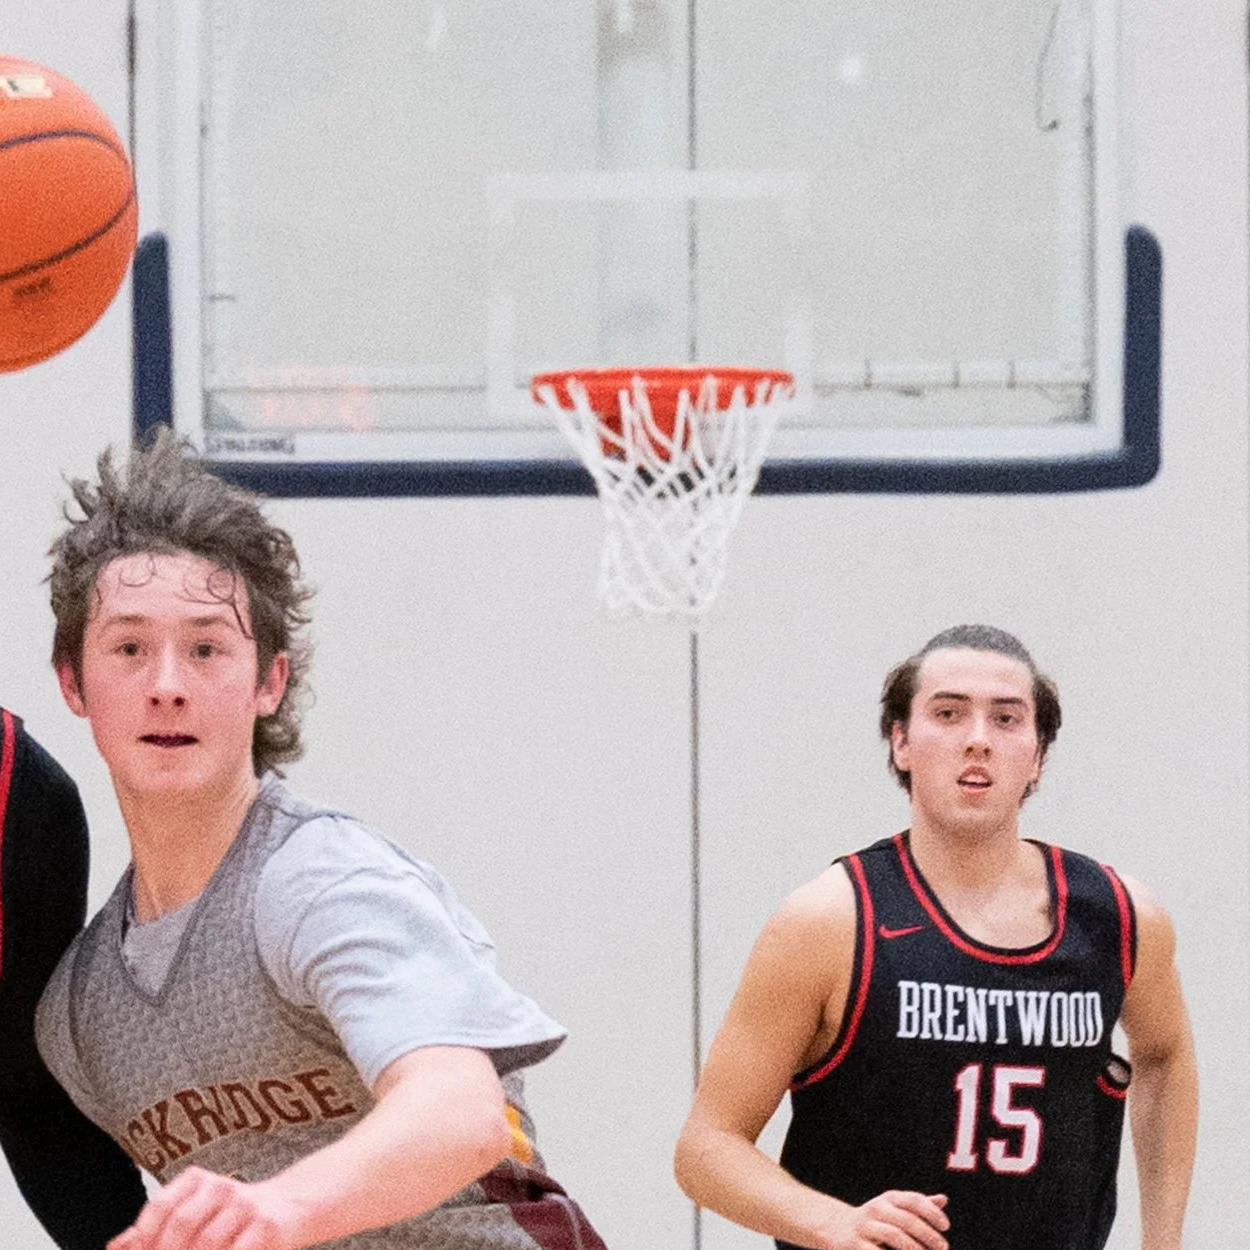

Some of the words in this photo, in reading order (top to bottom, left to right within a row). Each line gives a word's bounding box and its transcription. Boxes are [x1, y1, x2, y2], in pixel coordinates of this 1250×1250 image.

[896, 979, 1104, 1048] BRENTWOOD
[121, 1067, 357, 1178] CKRIDGE
[945, 1062, 1046, 1176] 15
